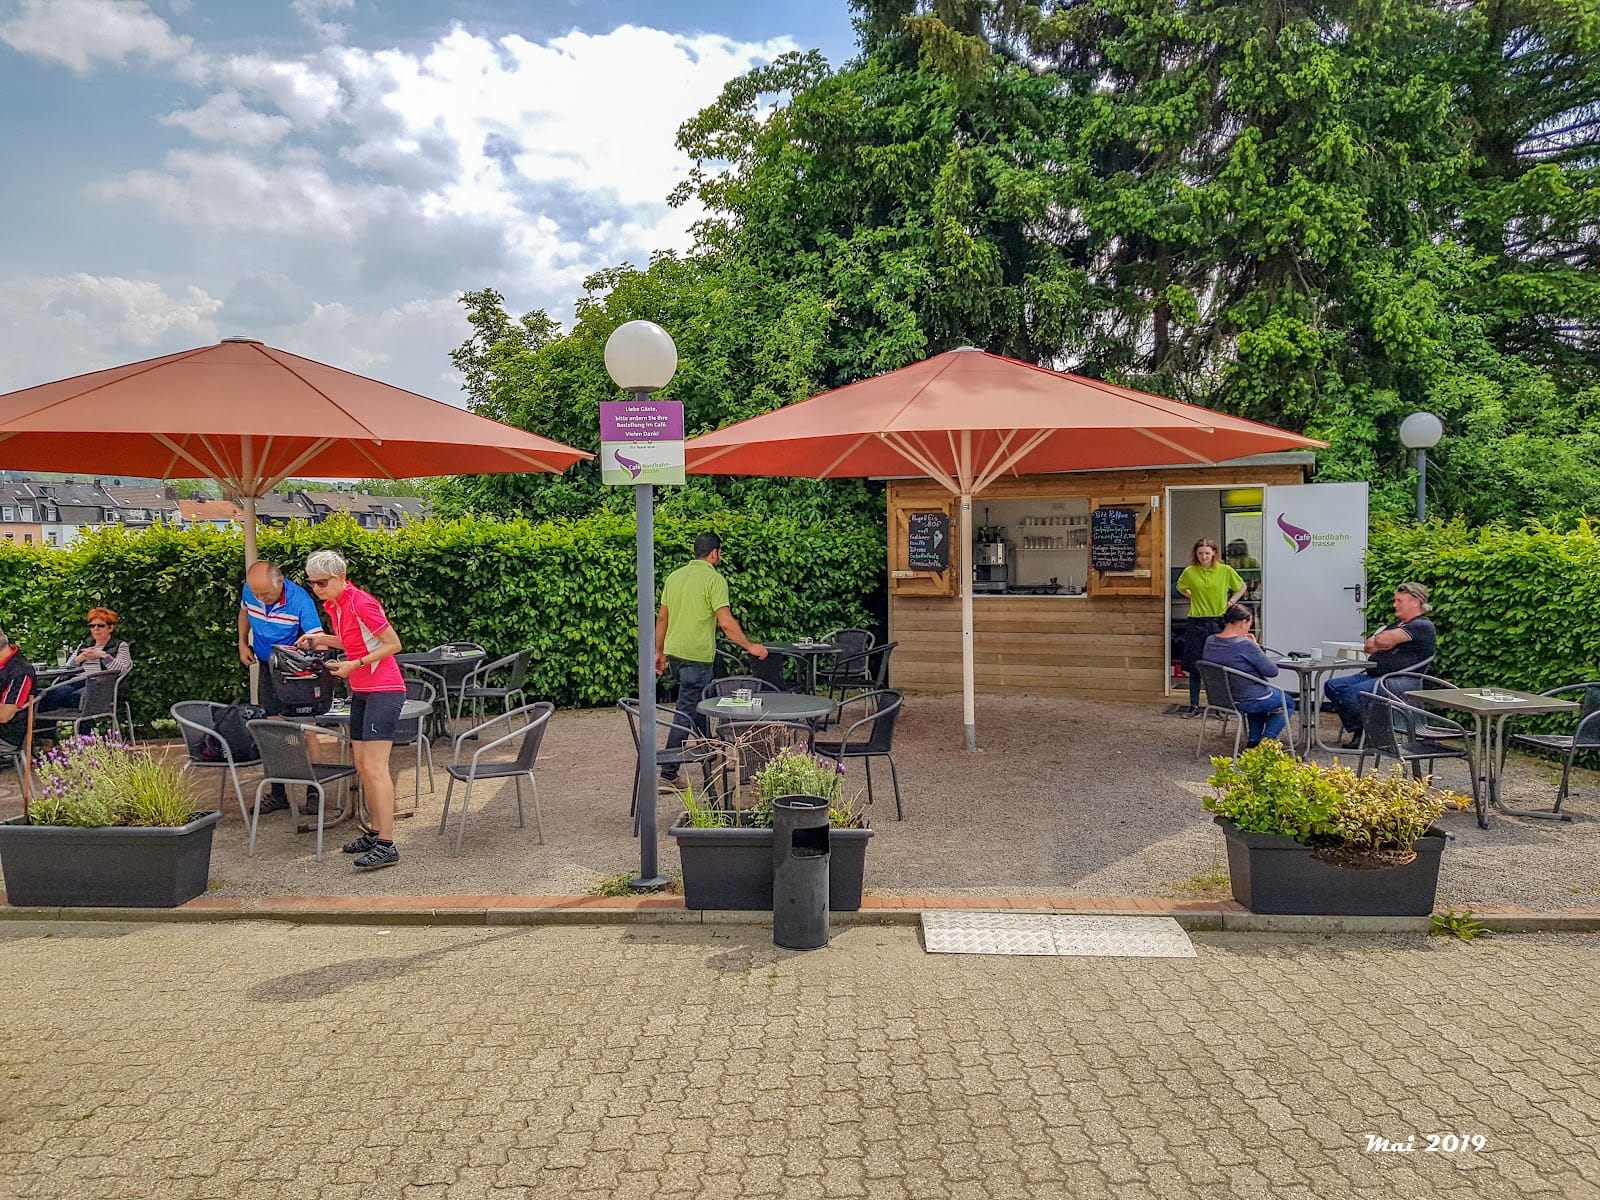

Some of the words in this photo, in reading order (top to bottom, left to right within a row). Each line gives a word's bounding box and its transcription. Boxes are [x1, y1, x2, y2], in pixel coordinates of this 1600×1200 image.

[640, 405, 658, 413] Gäste,
[1294, 533, 1311, 541] Café
[1312, 533, 1352, 541] Nordbahn-
